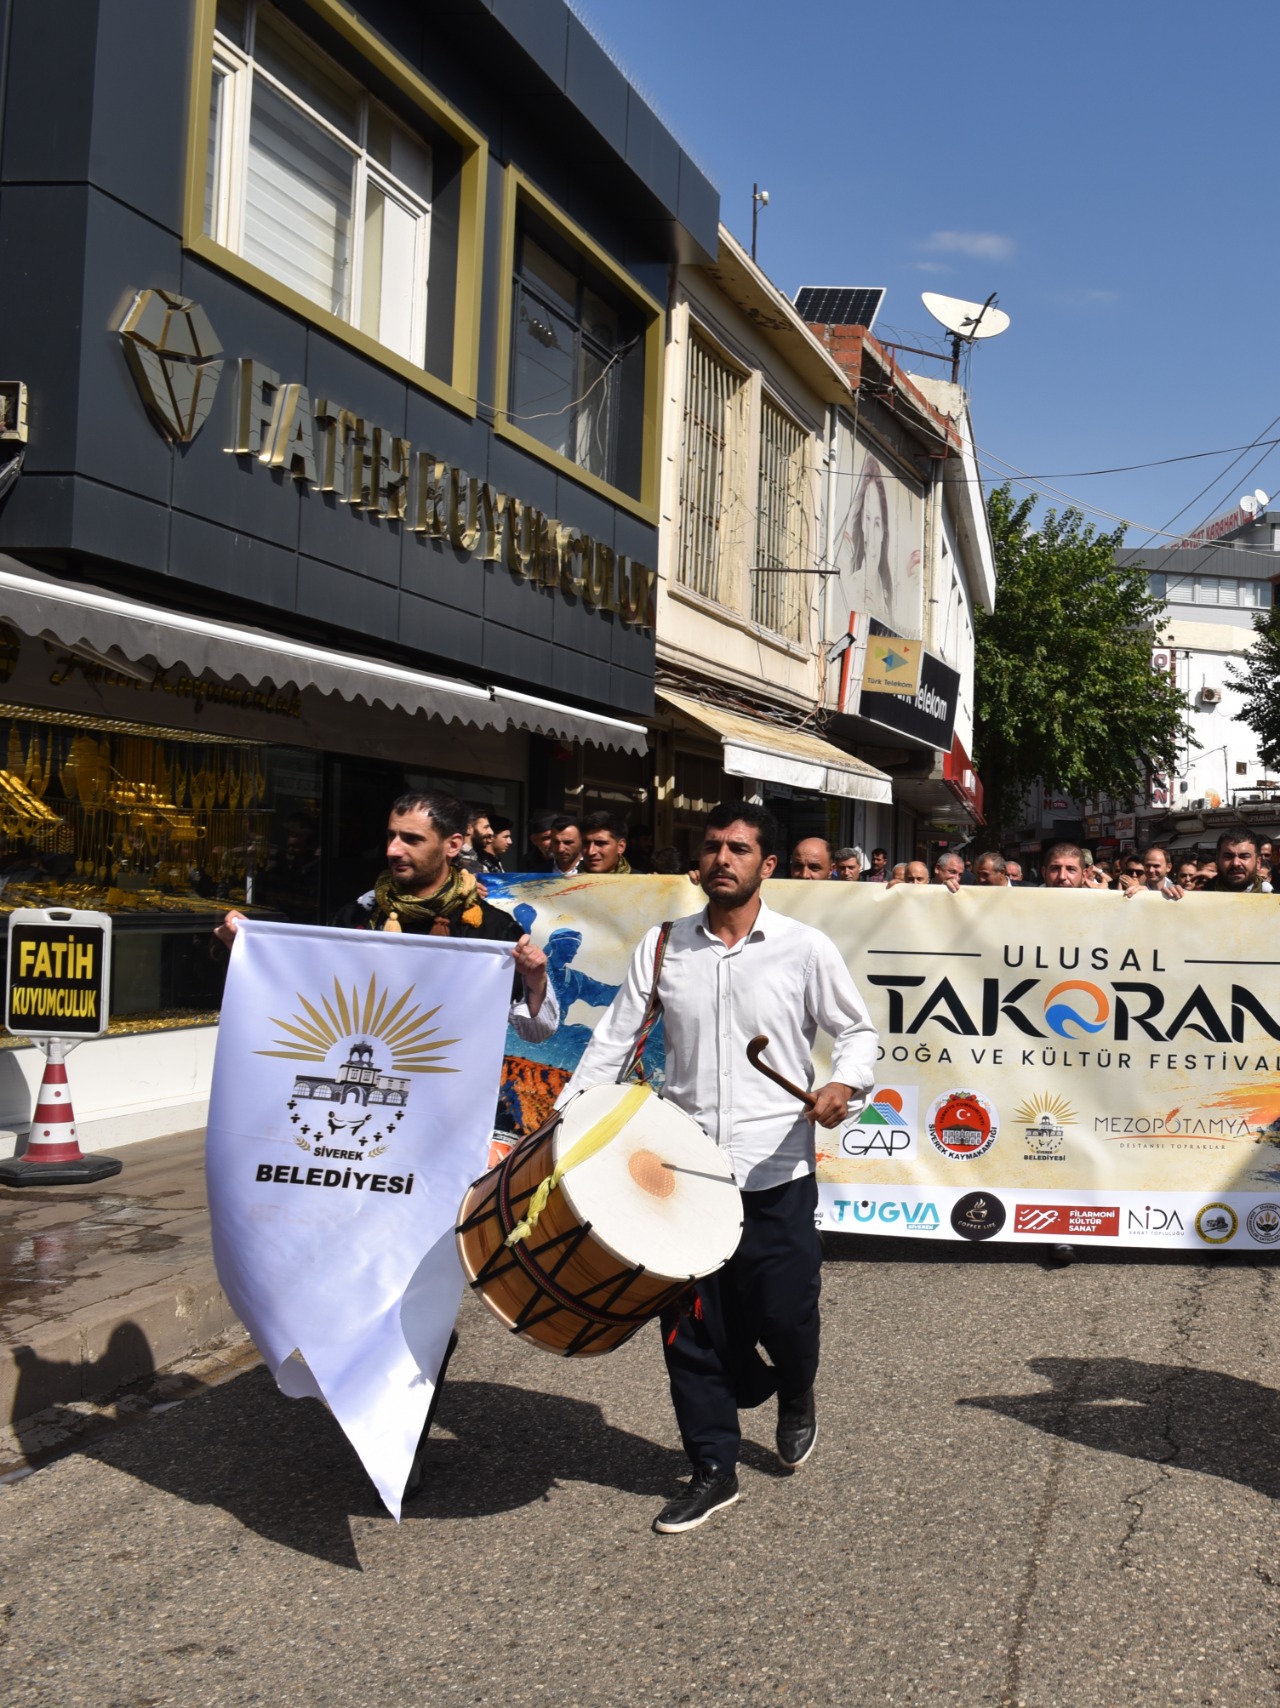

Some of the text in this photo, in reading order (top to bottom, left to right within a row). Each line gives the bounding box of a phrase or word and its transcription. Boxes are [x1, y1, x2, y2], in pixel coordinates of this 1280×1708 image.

[224, 357, 412, 522] FATİH
[867, 677, 913, 689] Türk Telekom
[20, 934, 94, 980] FATİH
[1003, 944, 1166, 972] ULUSAL
[11, 986, 97, 1018] KUYUMCULUK
[875, 1042, 953, 1064] DOĞA
[971, 1048, 1003, 1065] VE
[1021, 1044, 1132, 1069] KÜLTÜR
[1094, 1115, 1251, 1135] MEZOPOTAMYA
[314, 1146, 364, 1161] SİVEREK
[842, 1128, 911, 1157] GAP
[928, 1123, 999, 1161] SİVEREK KAYMAKAMLIĞI
[255, 1164, 415, 1195] BELEDİYESİ
[957, 1220, 997, 1230] COFFEE LIFE
[1069, 1208, 1115, 1218] FİLARMONİ
[1069, 1217, 1102, 1225] KÜLTÜR
[1128, 1205, 1184, 1231] NİDA
